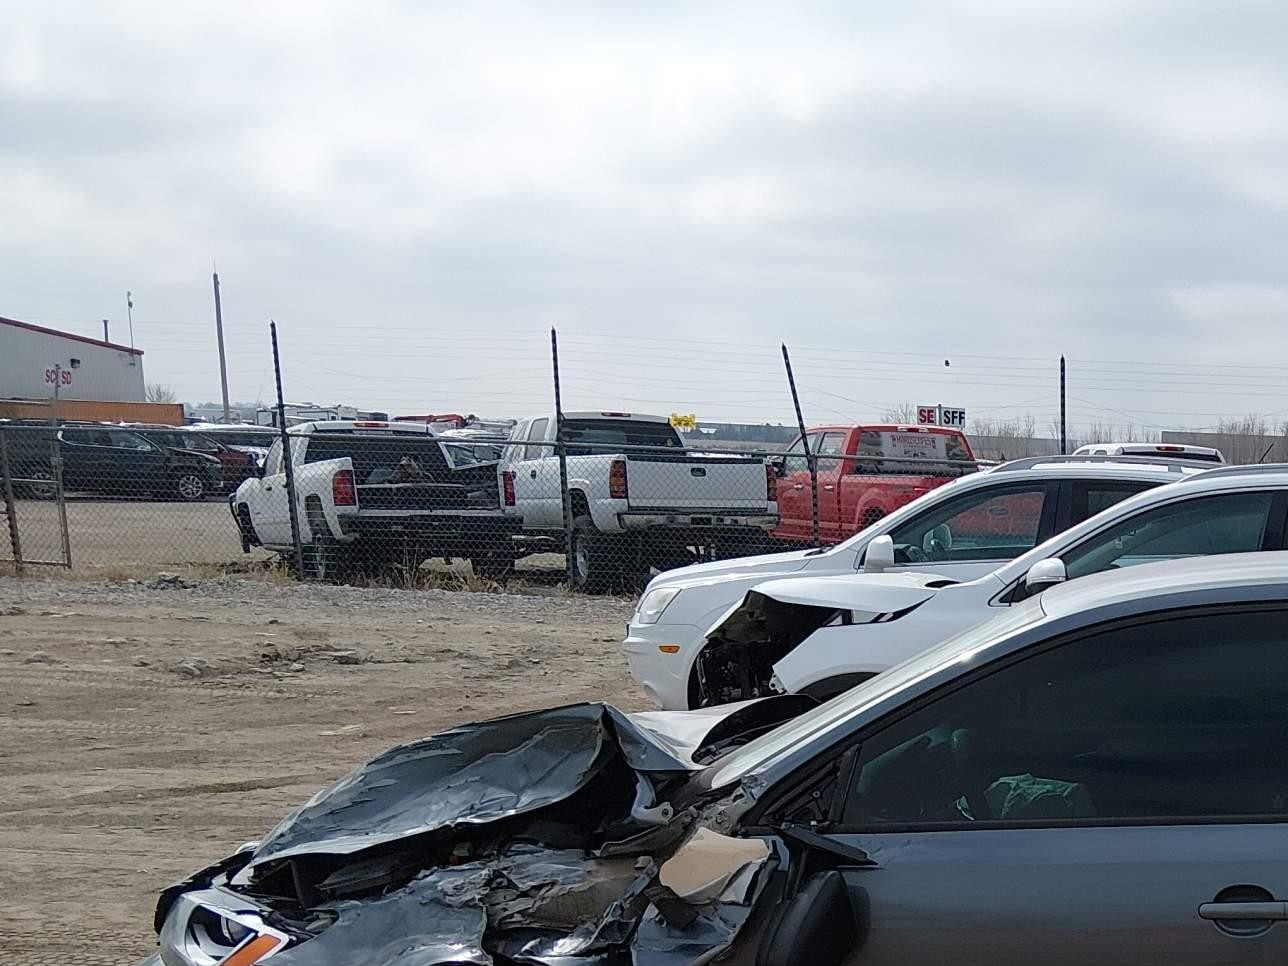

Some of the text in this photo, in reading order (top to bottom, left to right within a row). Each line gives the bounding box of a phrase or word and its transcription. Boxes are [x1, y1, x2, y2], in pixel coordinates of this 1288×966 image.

[61, 370, 72, 385] SD
[919, 408, 935, 424] SE
[943, 410, 966, 425] SFF
